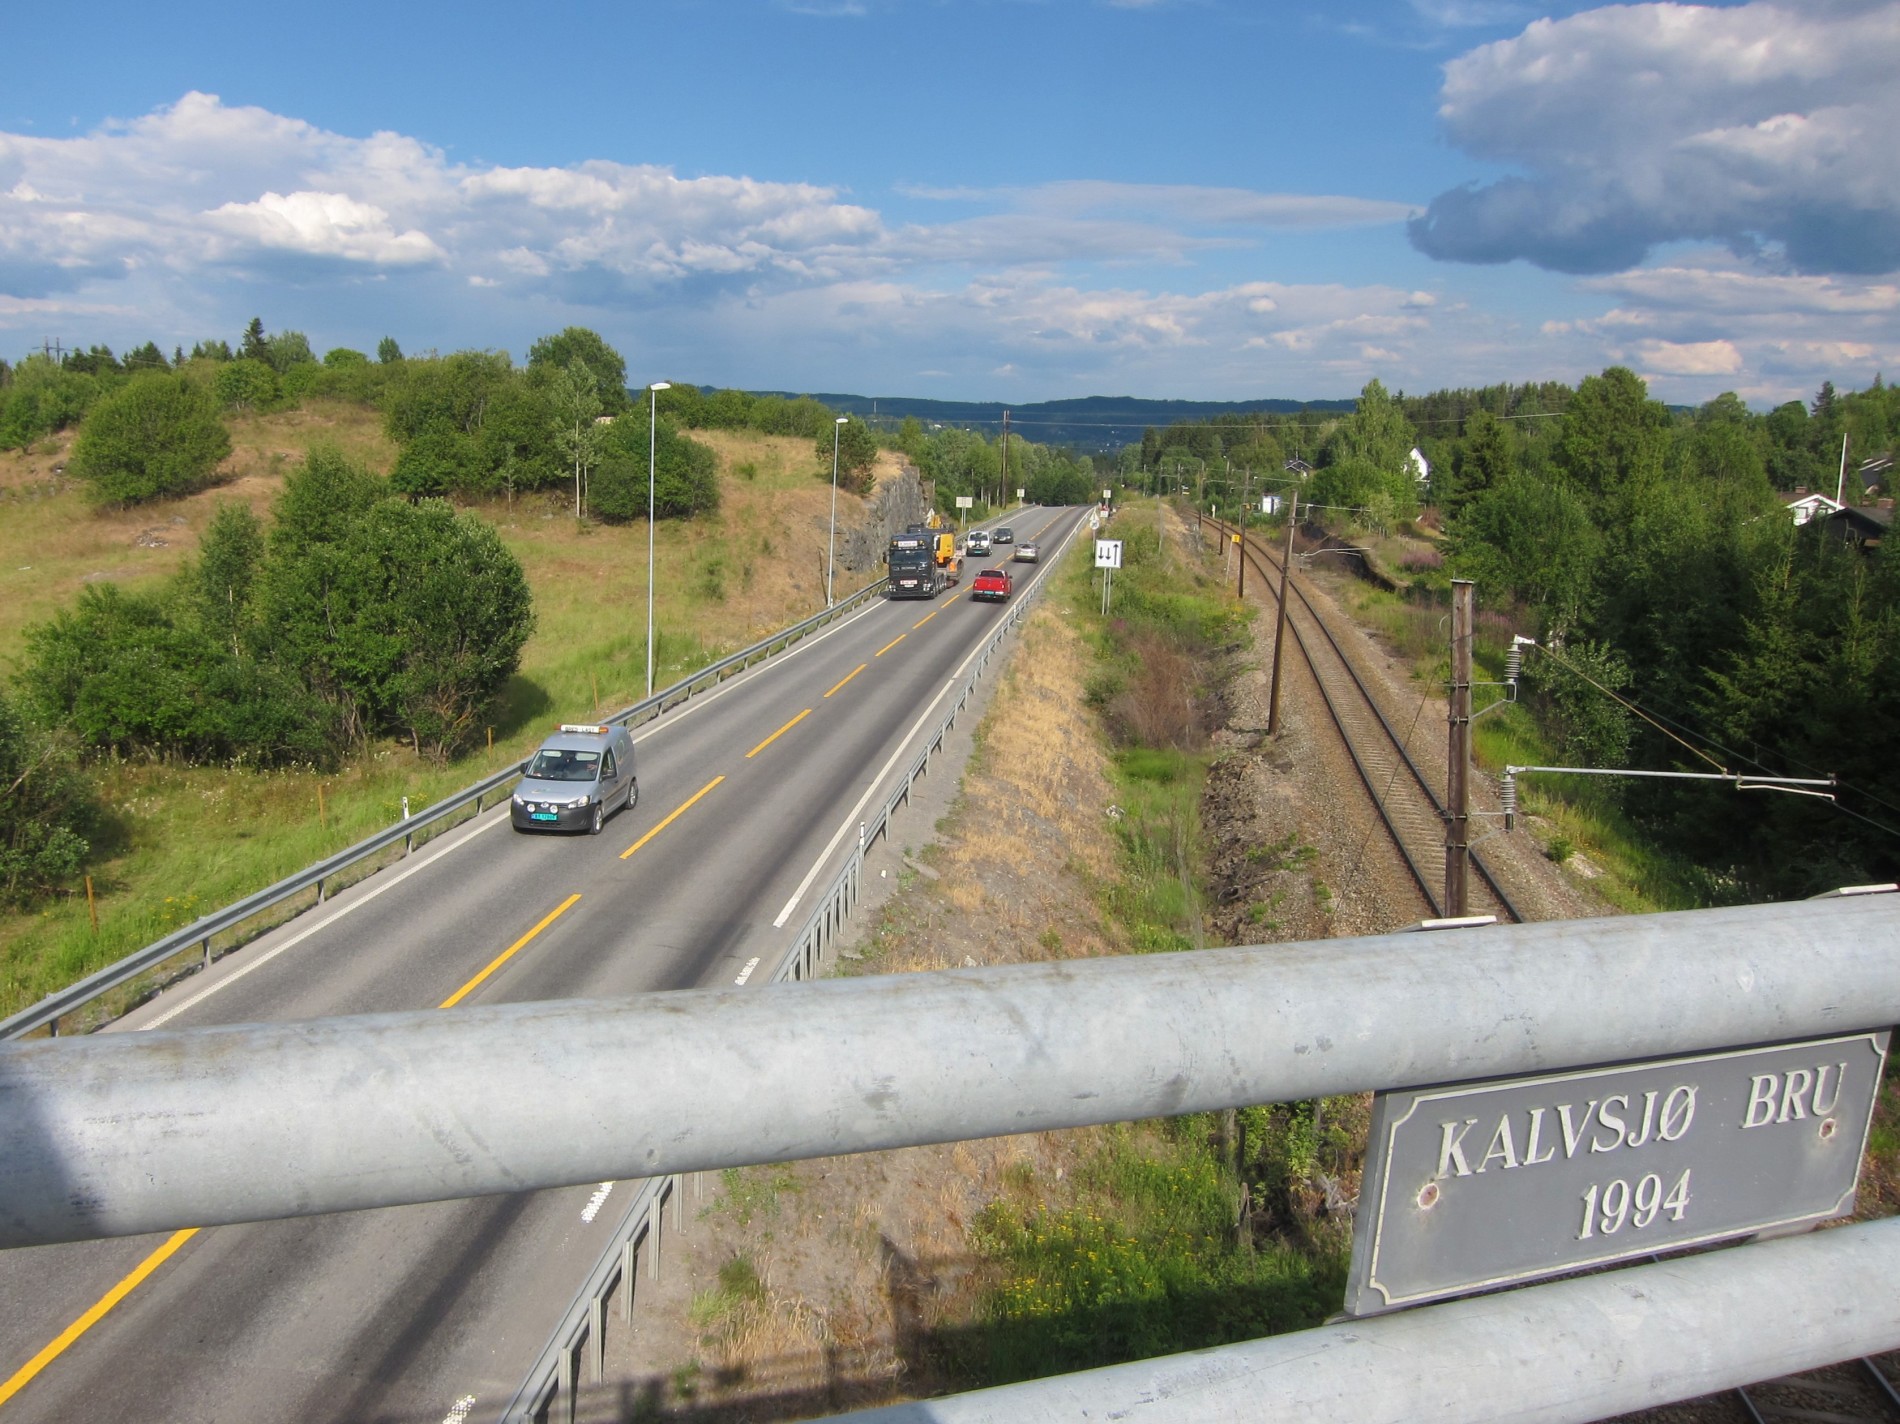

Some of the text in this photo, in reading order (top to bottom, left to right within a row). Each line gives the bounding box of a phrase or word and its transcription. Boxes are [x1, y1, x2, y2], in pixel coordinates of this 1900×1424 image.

[1435, 1062, 1847, 1180] KALVSJØ BRU
[1577, 1168, 1691, 1240] 1994
